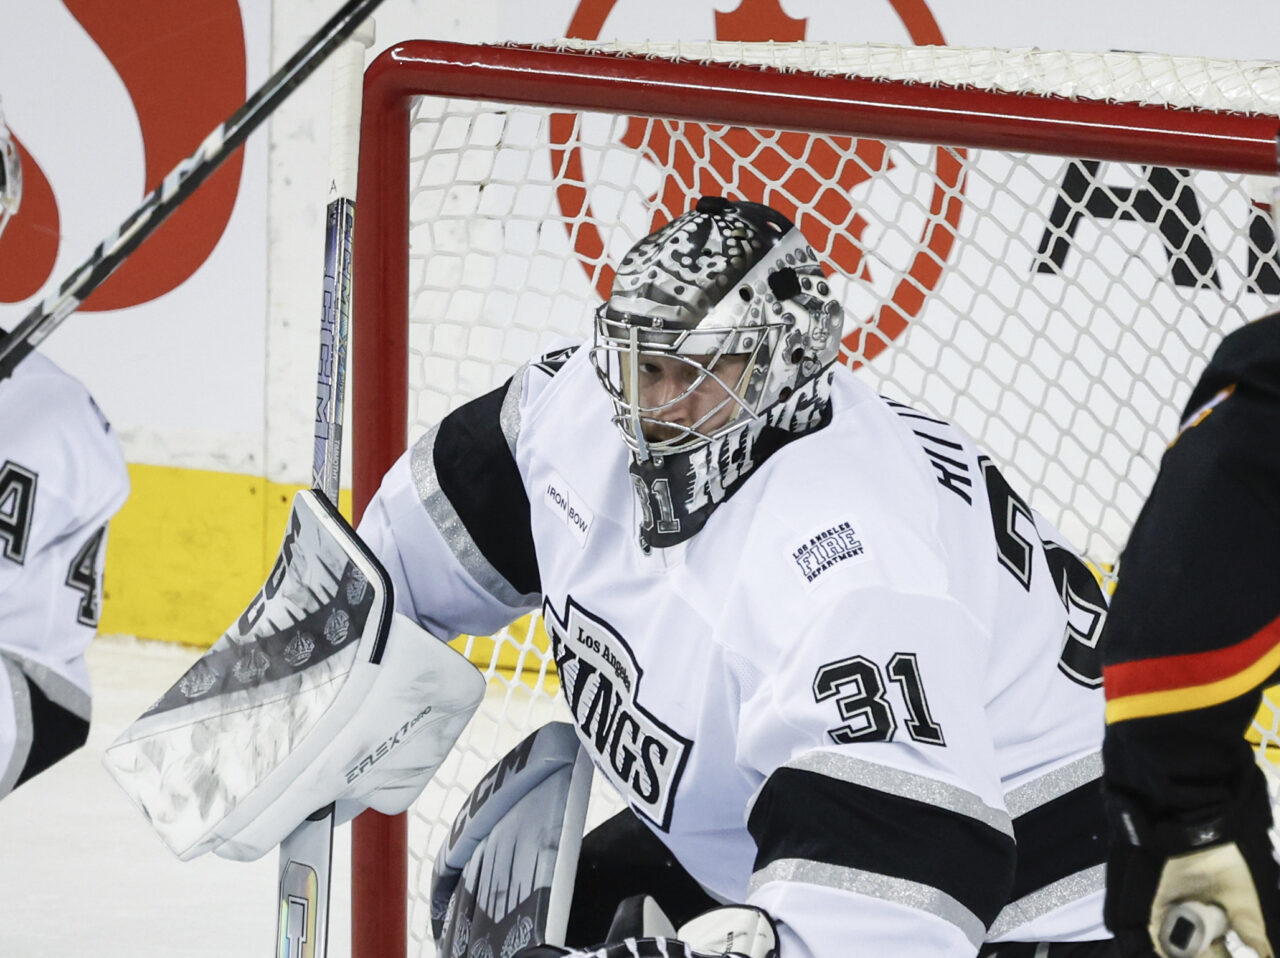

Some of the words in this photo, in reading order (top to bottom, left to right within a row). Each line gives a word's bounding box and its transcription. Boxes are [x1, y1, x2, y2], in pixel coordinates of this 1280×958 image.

[0, 460, 39, 566] A
[546, 484, 568, 511] IRON
[568, 507, 588, 533] BOW
[796, 527, 862, 577] FIRE
[806, 546, 865, 583] DEPARTMENT
[576, 626, 601, 656] Los
[551, 627, 669, 806] KINGS
[812, 652, 948, 748] 31
[450, 728, 541, 852] CCM
